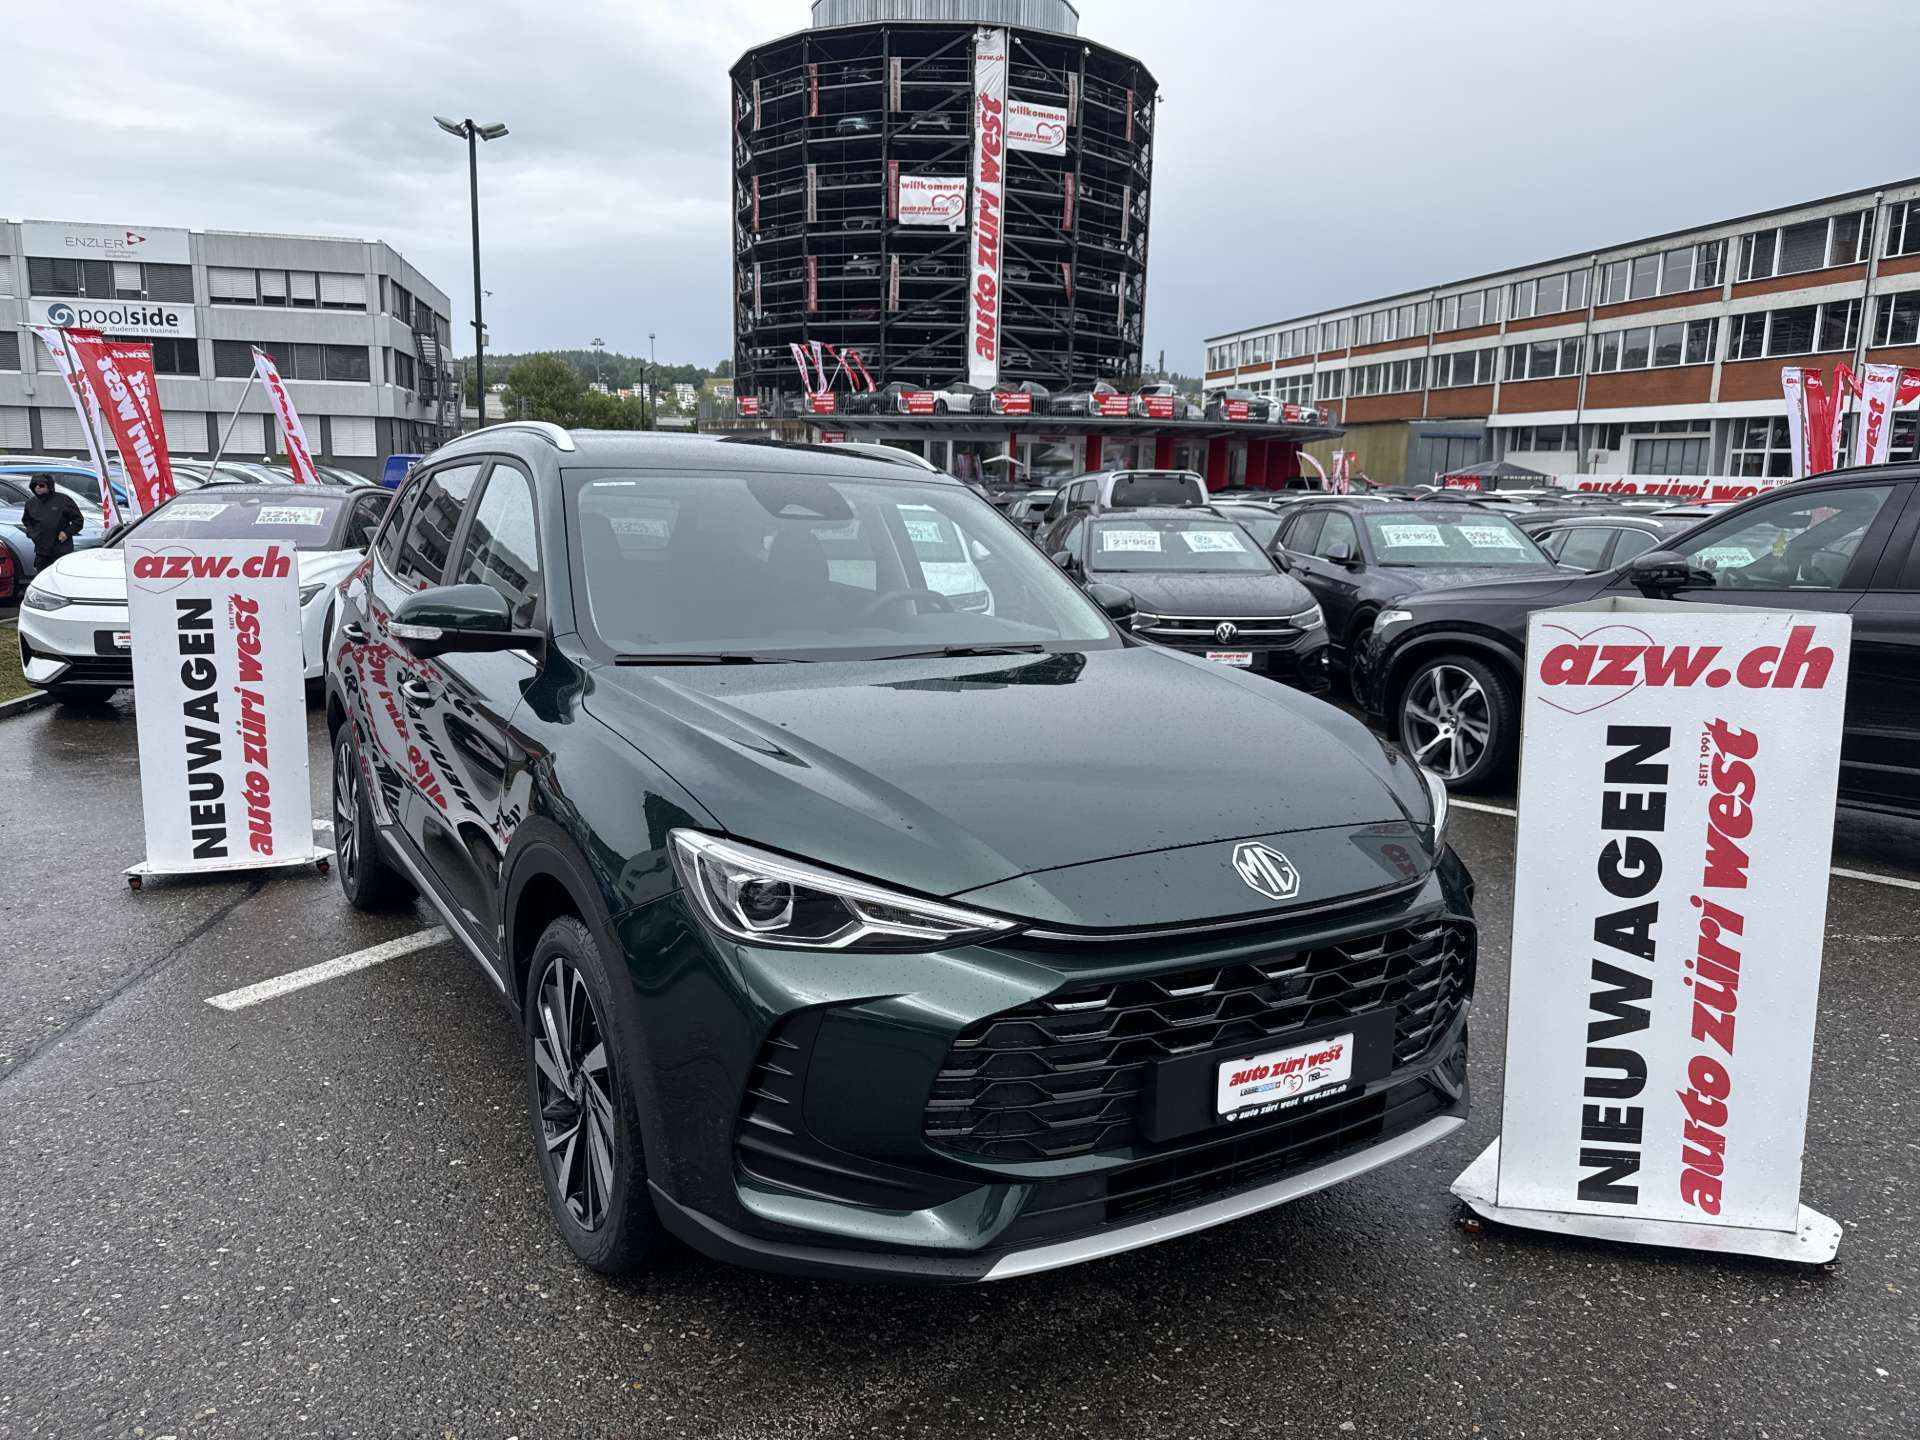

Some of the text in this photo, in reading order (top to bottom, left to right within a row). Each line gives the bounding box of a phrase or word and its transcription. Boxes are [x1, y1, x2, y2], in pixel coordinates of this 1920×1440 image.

[1008, 105, 1066, 121] willkommen
[901, 181, 965, 191] willkommen
[65, 236, 124, 249] ENZLER
[973, 92, 1002, 361] auto züri west
[78, 305, 178, 328] poolside
[133, 546, 291, 579] azw.ch
[1540, 625, 1834, 689] azw.ch
[176, 598, 229, 860] NEUWAGEN
[229, 593, 274, 856] auto züri west
[1697, 730, 1711, 787] SEIT 1991
[1238, 846, 1295, 893] MG
[1577, 724, 1672, 1205] NEUWAGEN
[1675, 717, 1759, 1216] auto züri west
[1229, 1045, 1344, 1088] auto züri west
[1238, 1084, 1348, 1120] auto züri west www.azw.ch
